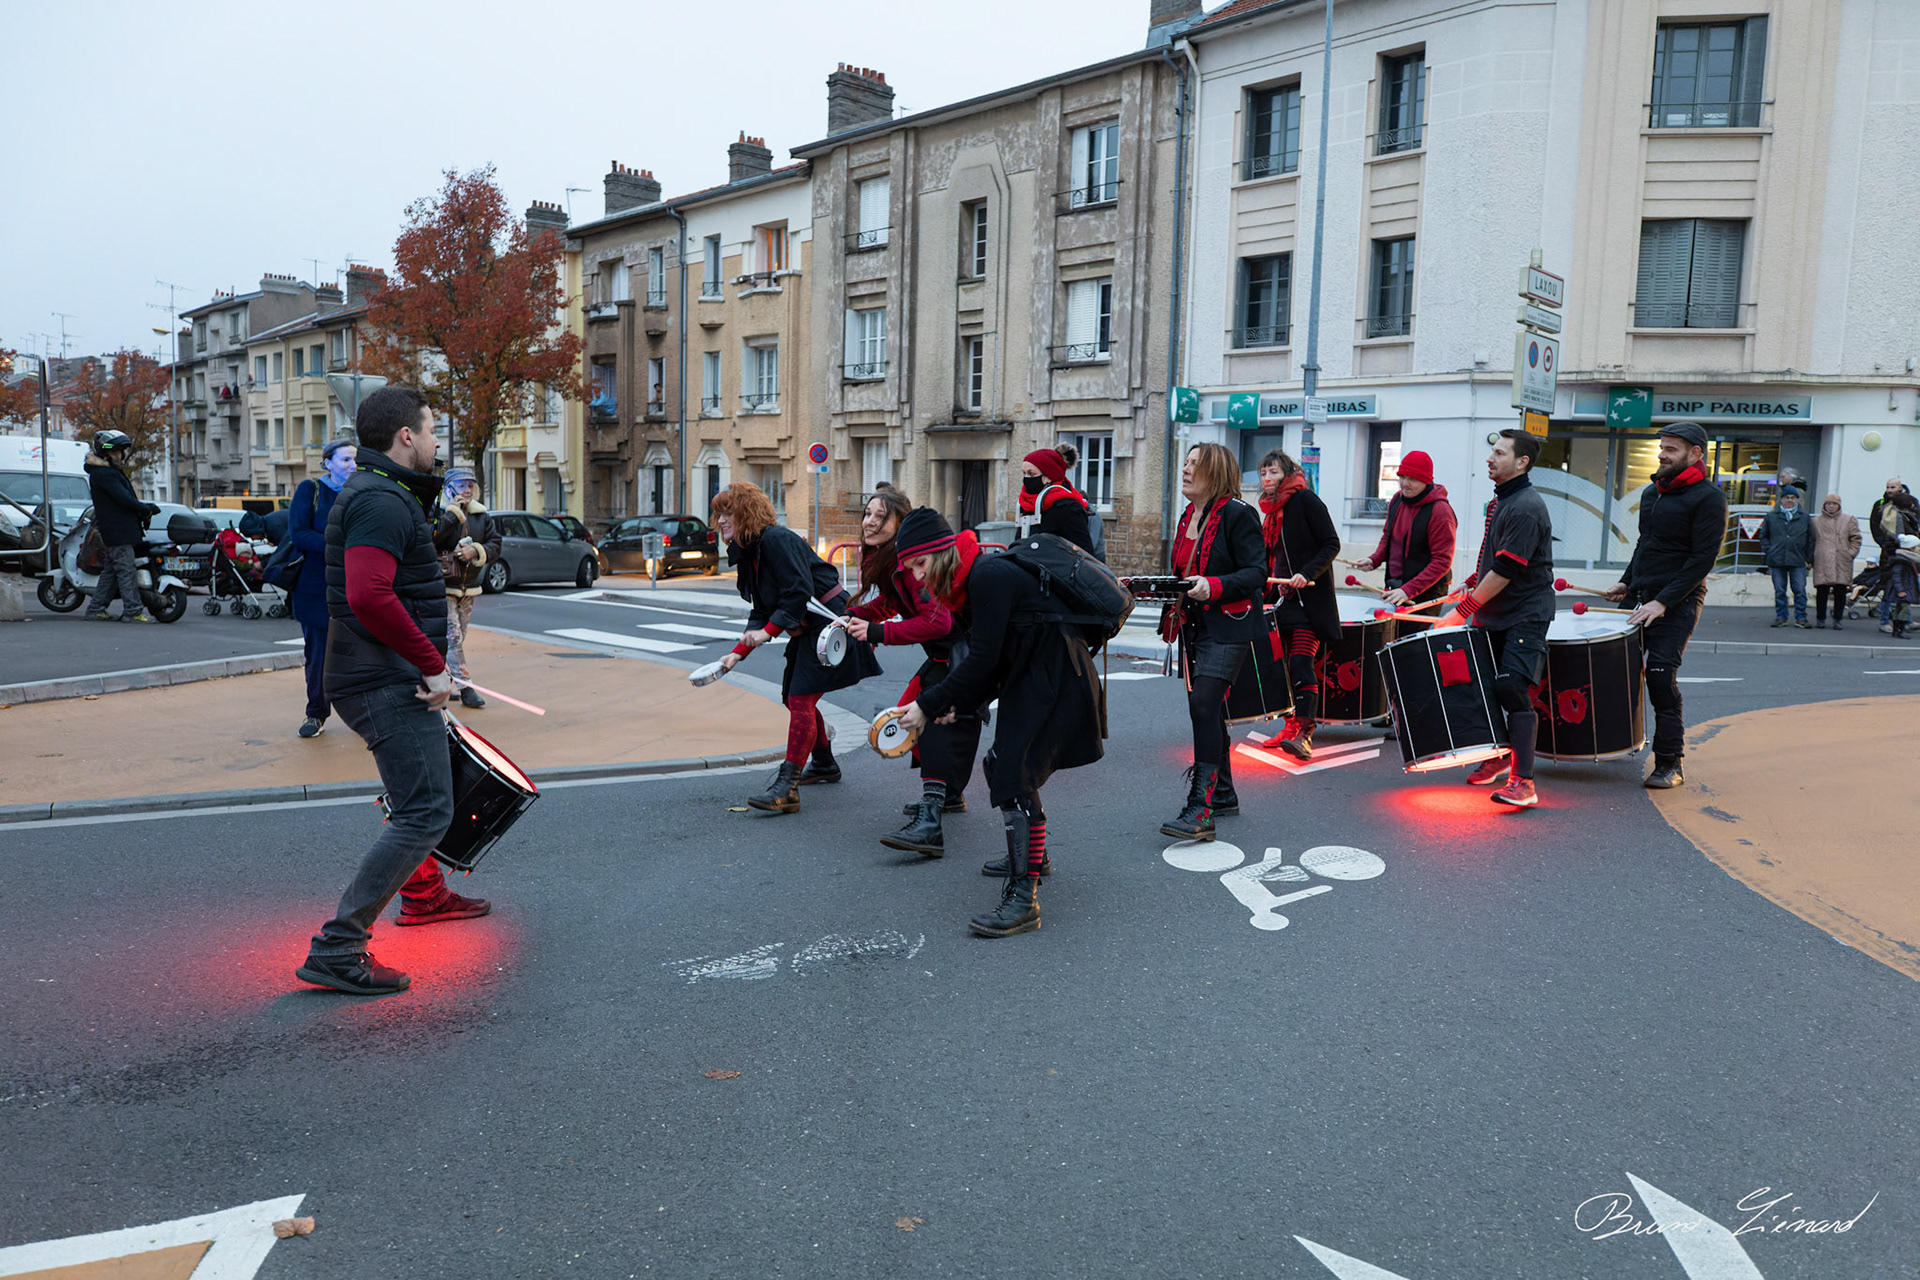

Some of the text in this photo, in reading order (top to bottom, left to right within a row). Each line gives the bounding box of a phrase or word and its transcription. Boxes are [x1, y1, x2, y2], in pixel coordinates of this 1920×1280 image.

[1535, 276, 1557, 297] LAXOU
[1269, 404, 1298, 414] BNP
[1662, 401, 1799, 415] BNP PARIBAS
